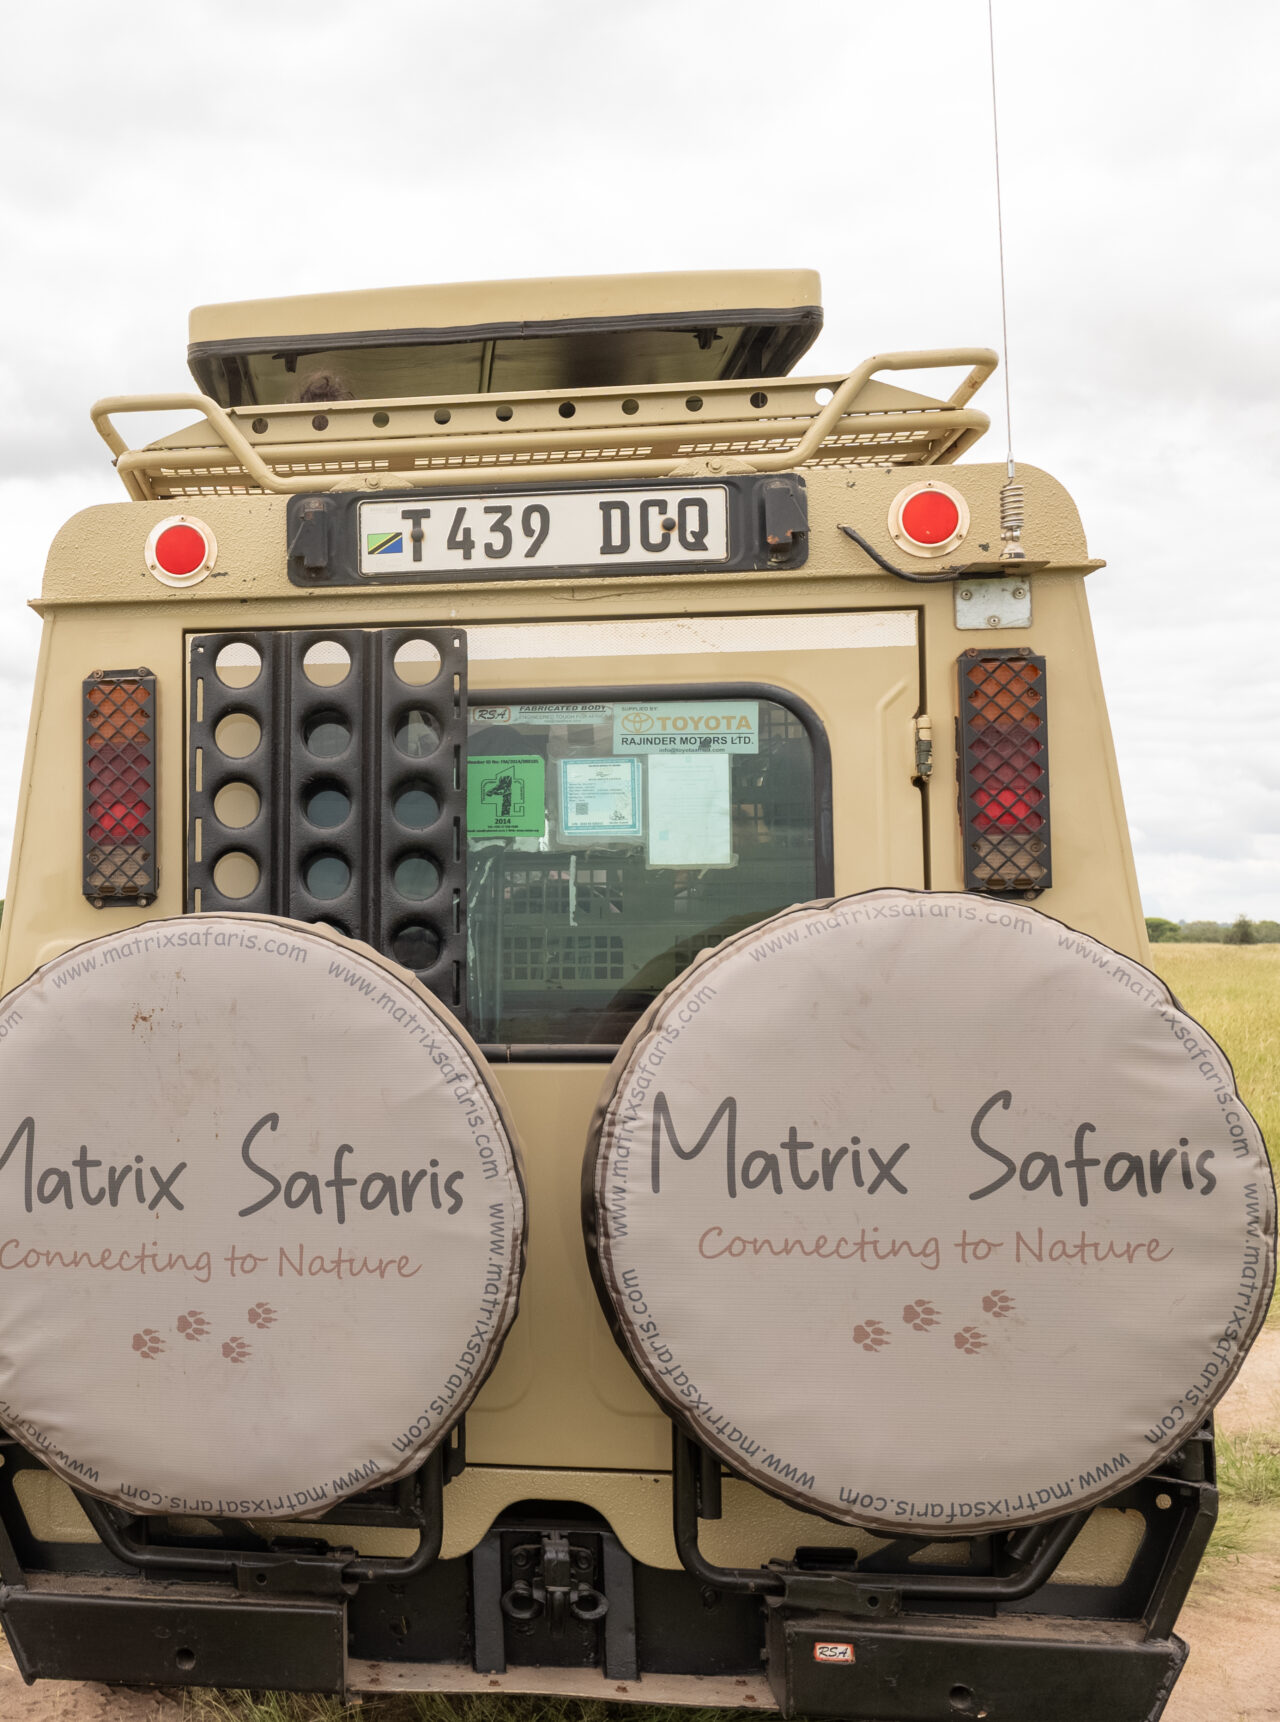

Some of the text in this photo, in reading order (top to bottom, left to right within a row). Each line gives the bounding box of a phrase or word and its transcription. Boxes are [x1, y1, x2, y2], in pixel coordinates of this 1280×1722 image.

[400, 496, 710, 562] T 439 DCQ
[477, 708, 508, 720] RSA
[520, 703, 606, 712] FABRICATED BODY
[656, 715, 752, 731] TOYOTA
[621, 736, 754, 745] RAJINDER MOTORS LTD.
[52, 926, 308, 989] www.matrixsafaris.com
[749, 899, 1033, 963] www.matrixsafaris.com
[328, 960, 499, 1180] www.matrixsafaris.com
[1058, 934, 1249, 1159] www.matrixsafaris.com
[613, 984, 717, 1239] www.matrixsafaris.com
[238, 1112, 465, 1224] Safaris
[651, 1090, 1218, 1207] Matrix Safaris
[224, 1244, 270, 1275] to
[277, 1243, 423, 1280] Nature
[698, 1227, 1174, 1270] Connecting to Nature
[392, 1203, 505, 1452] www.matrixsafaris.com
[1144, 1183, 1259, 1444] www.matrixsafaris.com
[622, 1268, 816, 1489] www.matrixsafaris.com
[120, 1459, 381, 1514] www.matrixsafaris.com
[839, 1452, 1131, 1523] www.matrixsafaris.com
[818, 1646, 848, 1657] RSA
